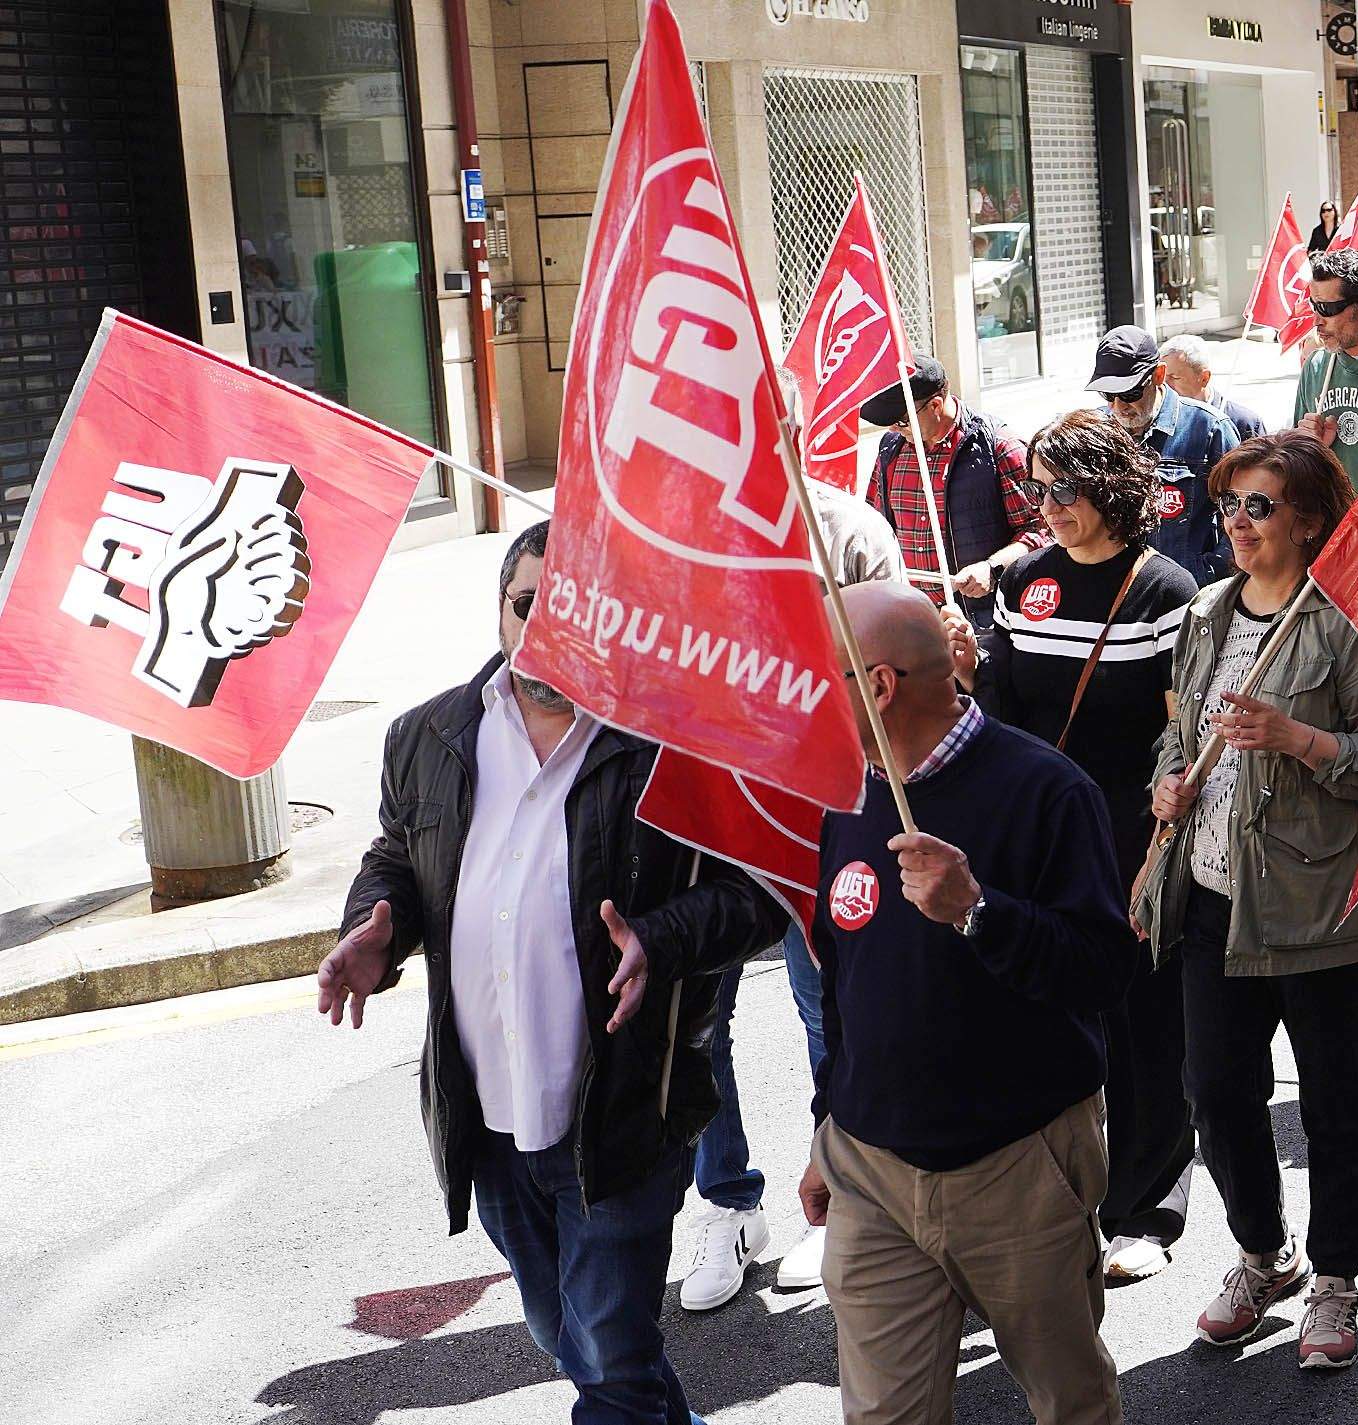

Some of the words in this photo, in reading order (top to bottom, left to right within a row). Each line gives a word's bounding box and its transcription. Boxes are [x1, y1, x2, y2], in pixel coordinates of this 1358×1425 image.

[1041, 16, 1068, 37] Italian
[1069, 20, 1098, 42] Lingerie
[1029, 584, 1057, 602] UGT
[838, 870, 876, 899] UGT
